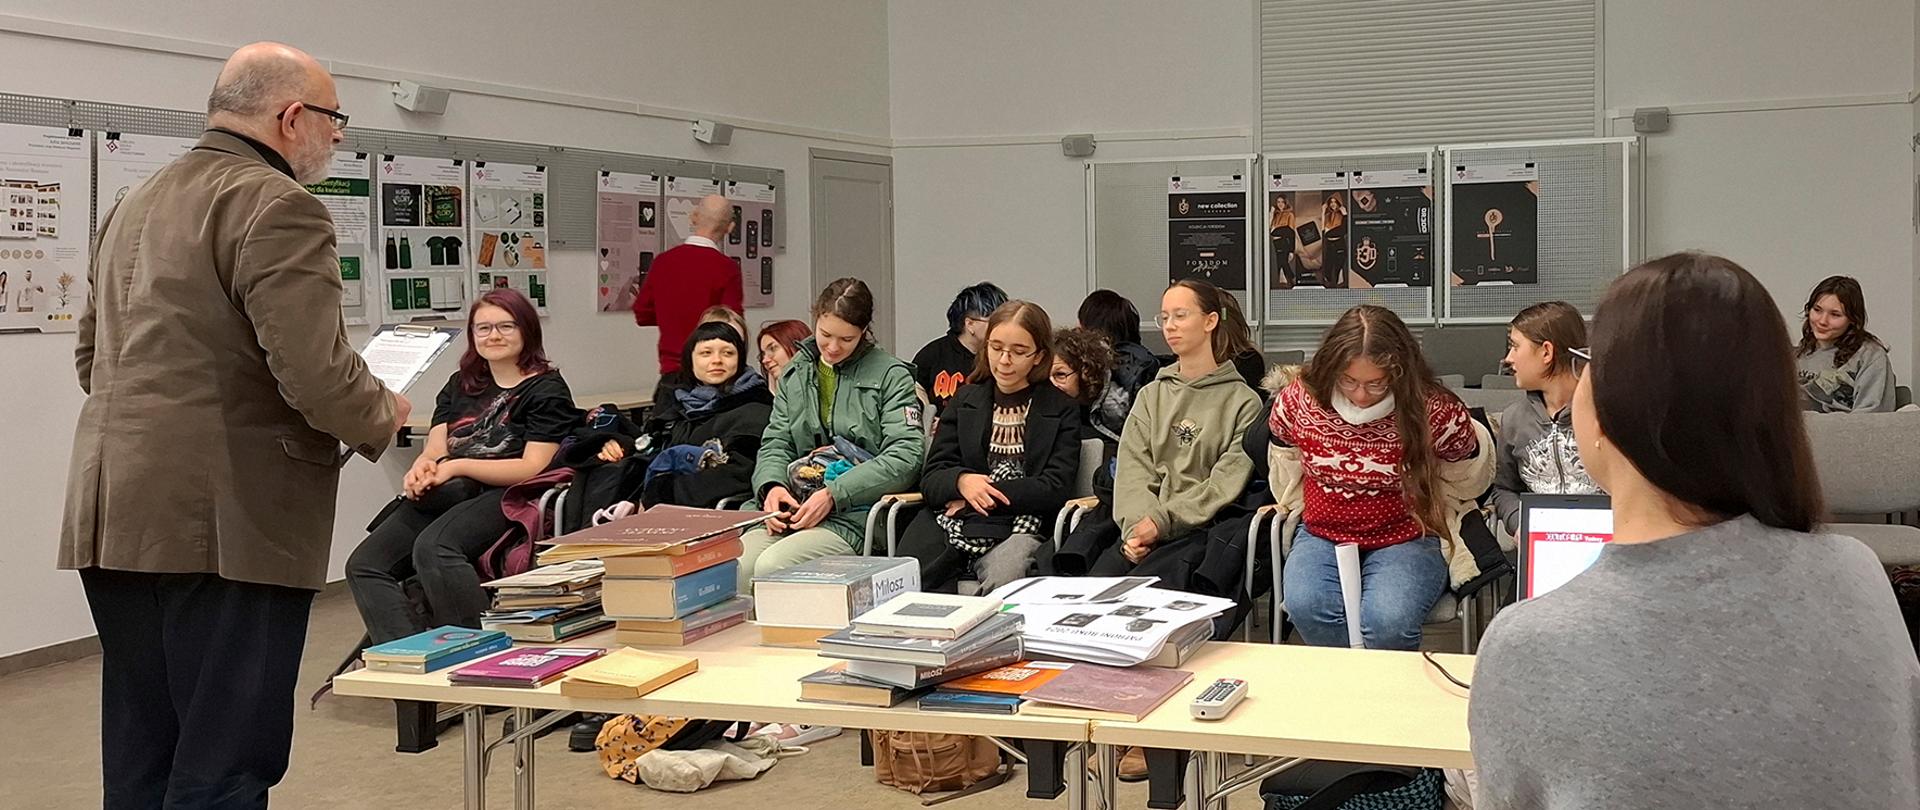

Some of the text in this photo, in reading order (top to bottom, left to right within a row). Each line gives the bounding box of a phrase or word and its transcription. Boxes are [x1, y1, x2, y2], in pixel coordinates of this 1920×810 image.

[875, 575, 904, 599] Miłosz
[1100, 632, 1144, 641] PATRONI
[919, 667, 944, 681] MIŁOSZ
